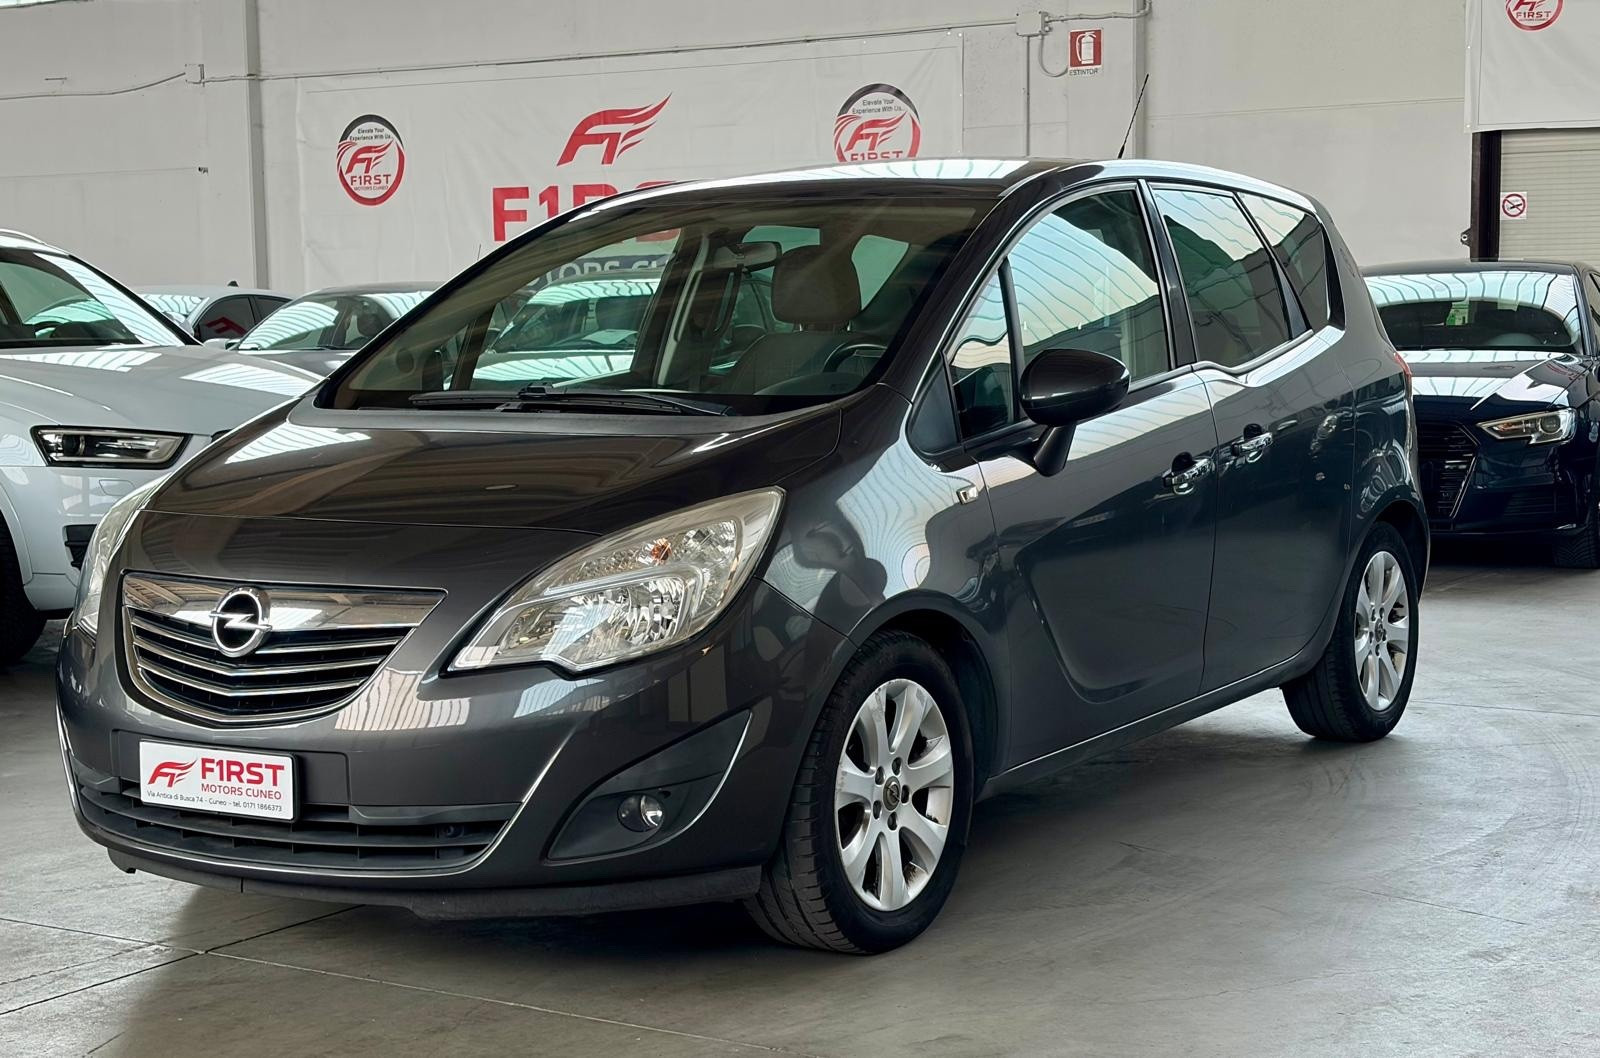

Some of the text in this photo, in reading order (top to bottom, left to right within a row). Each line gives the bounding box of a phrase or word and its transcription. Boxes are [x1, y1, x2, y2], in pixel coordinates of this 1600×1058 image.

[852, 106, 881, 114] Experience
[350, 174, 391, 186] F1RST
[201, 757, 285, 787] F1RST
[201, 783, 282, 800] MOTORS CUNEO
[147, 789, 155, 797] Via
[156, 791, 173, 800] Antica
[180, 794, 195, 802] Busca
[209, 797, 227, 806] Cuneo
[243, 801, 256, 809] 0171
[257, 803, 282, 812] 1866373
